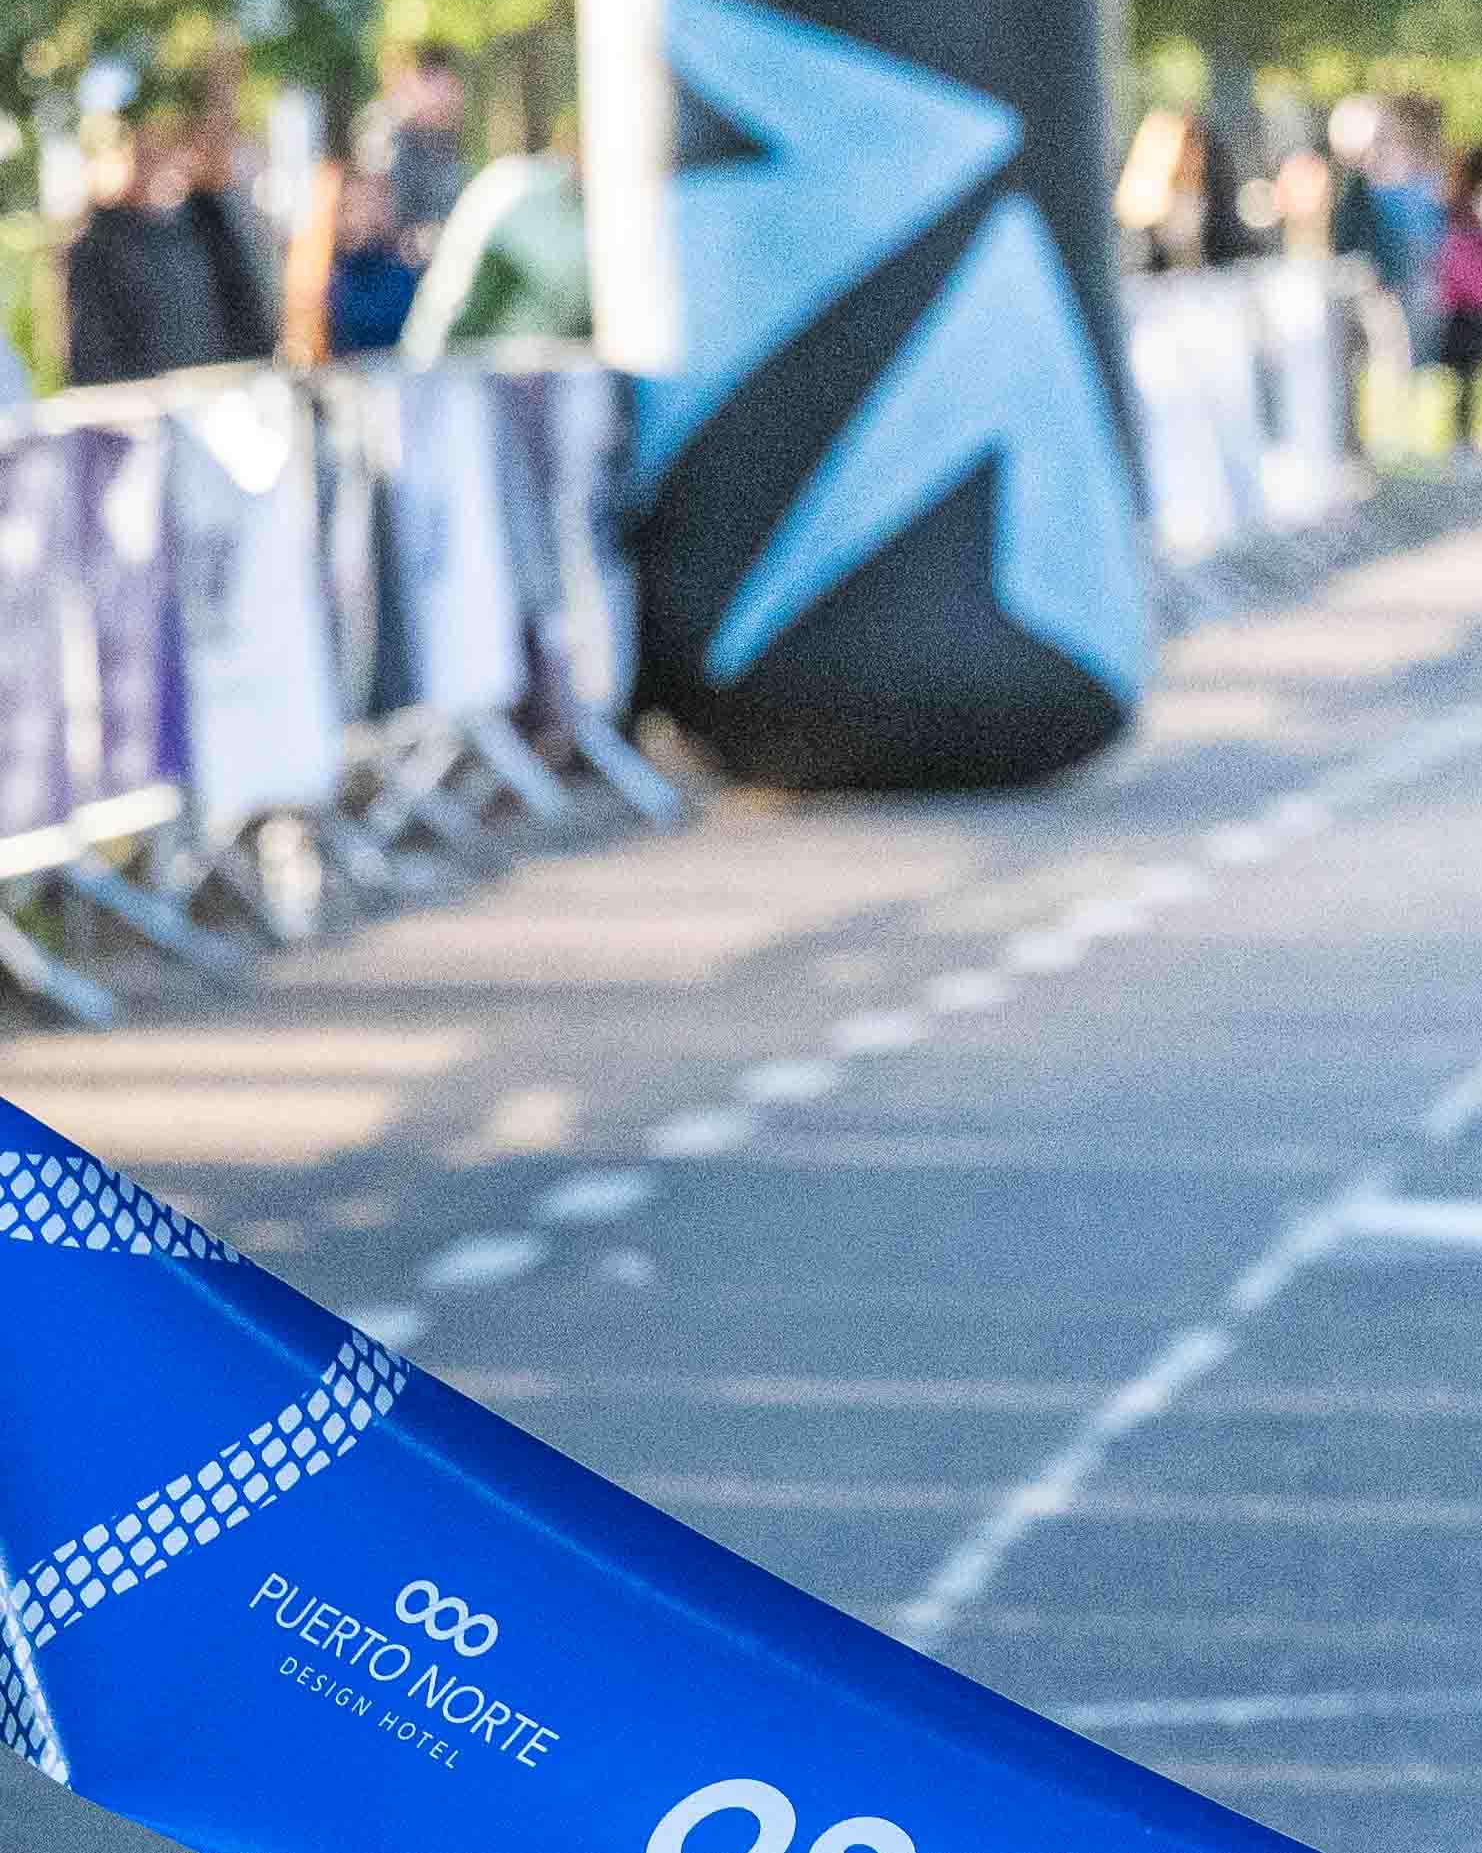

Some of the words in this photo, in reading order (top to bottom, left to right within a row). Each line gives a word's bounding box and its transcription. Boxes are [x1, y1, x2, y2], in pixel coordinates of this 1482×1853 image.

[249, 1573, 411, 1681] PUERTO
[408, 1665, 561, 1767] NORTE
[279, 1657, 373, 1717] DESIGN
[377, 1711, 459, 1769] HOTEL
